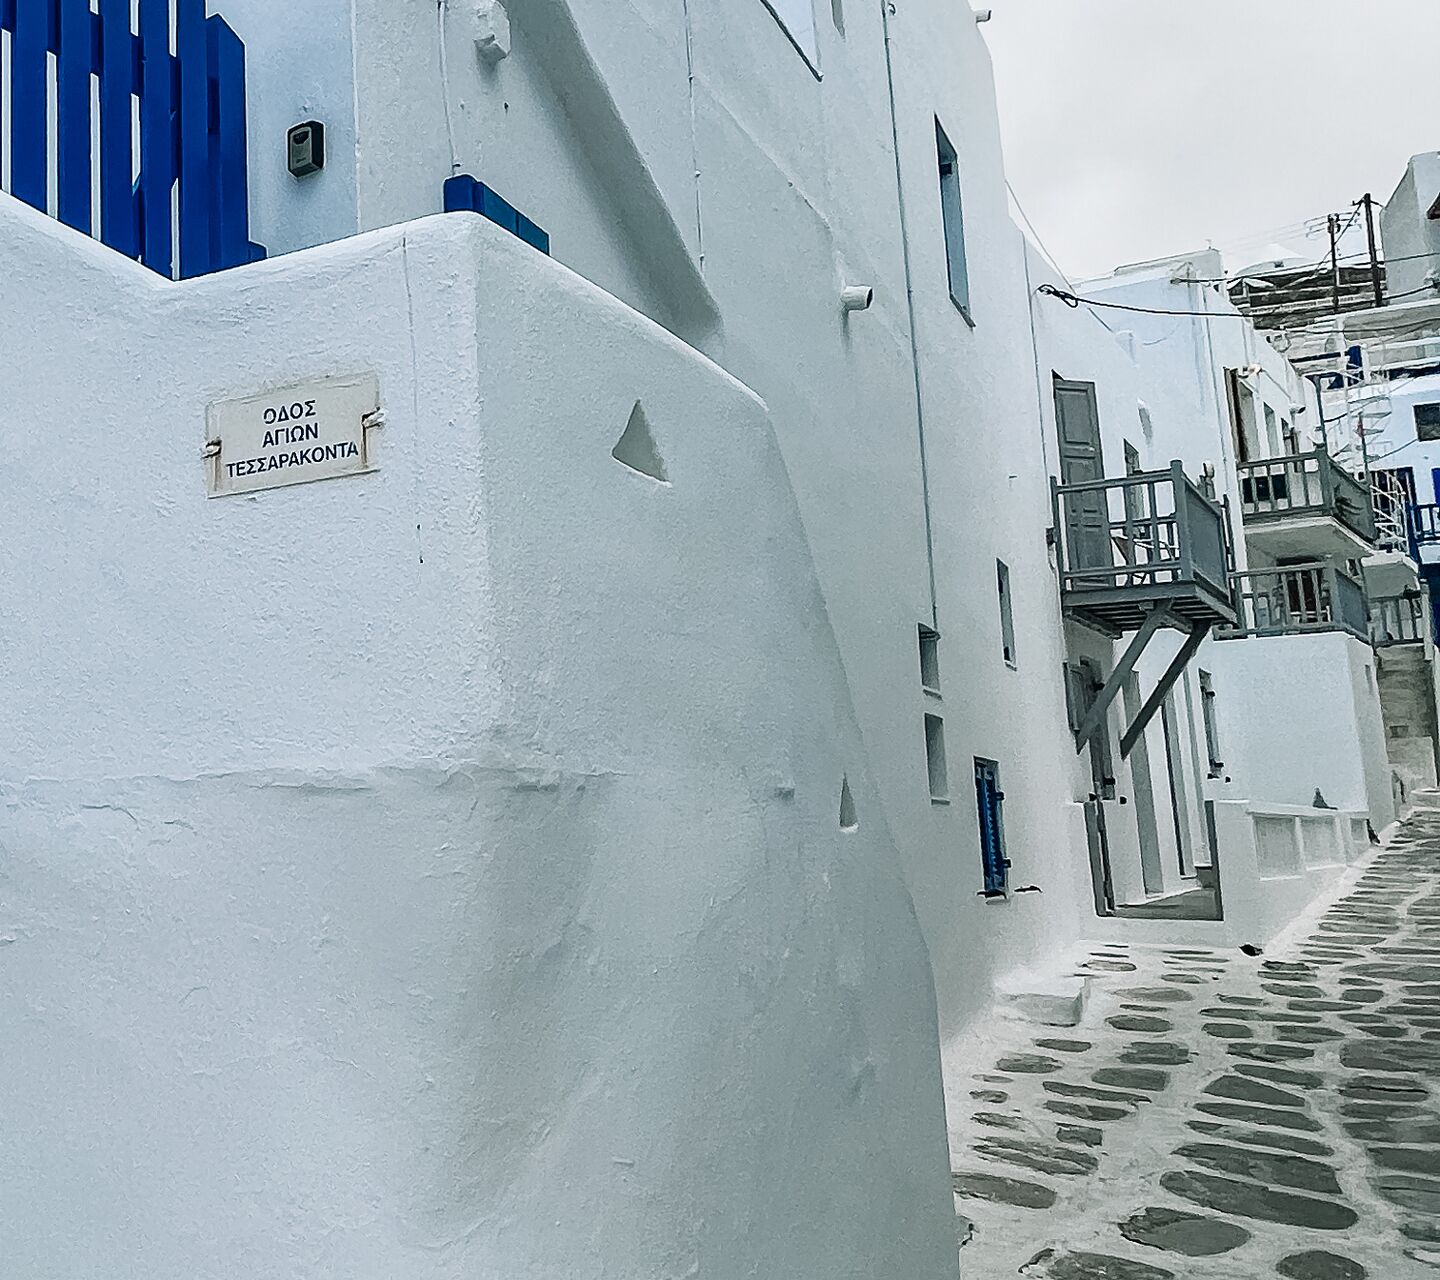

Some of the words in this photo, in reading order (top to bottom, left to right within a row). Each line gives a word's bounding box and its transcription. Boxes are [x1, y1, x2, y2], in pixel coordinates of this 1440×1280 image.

[263, 400, 316, 424] ΟΔΟΣ
[262, 423, 318, 448] ΑΓΙΩΝ
[225, 441, 359, 478] ΤΕΣΣΑΡΑΚΟΝΤΑ
